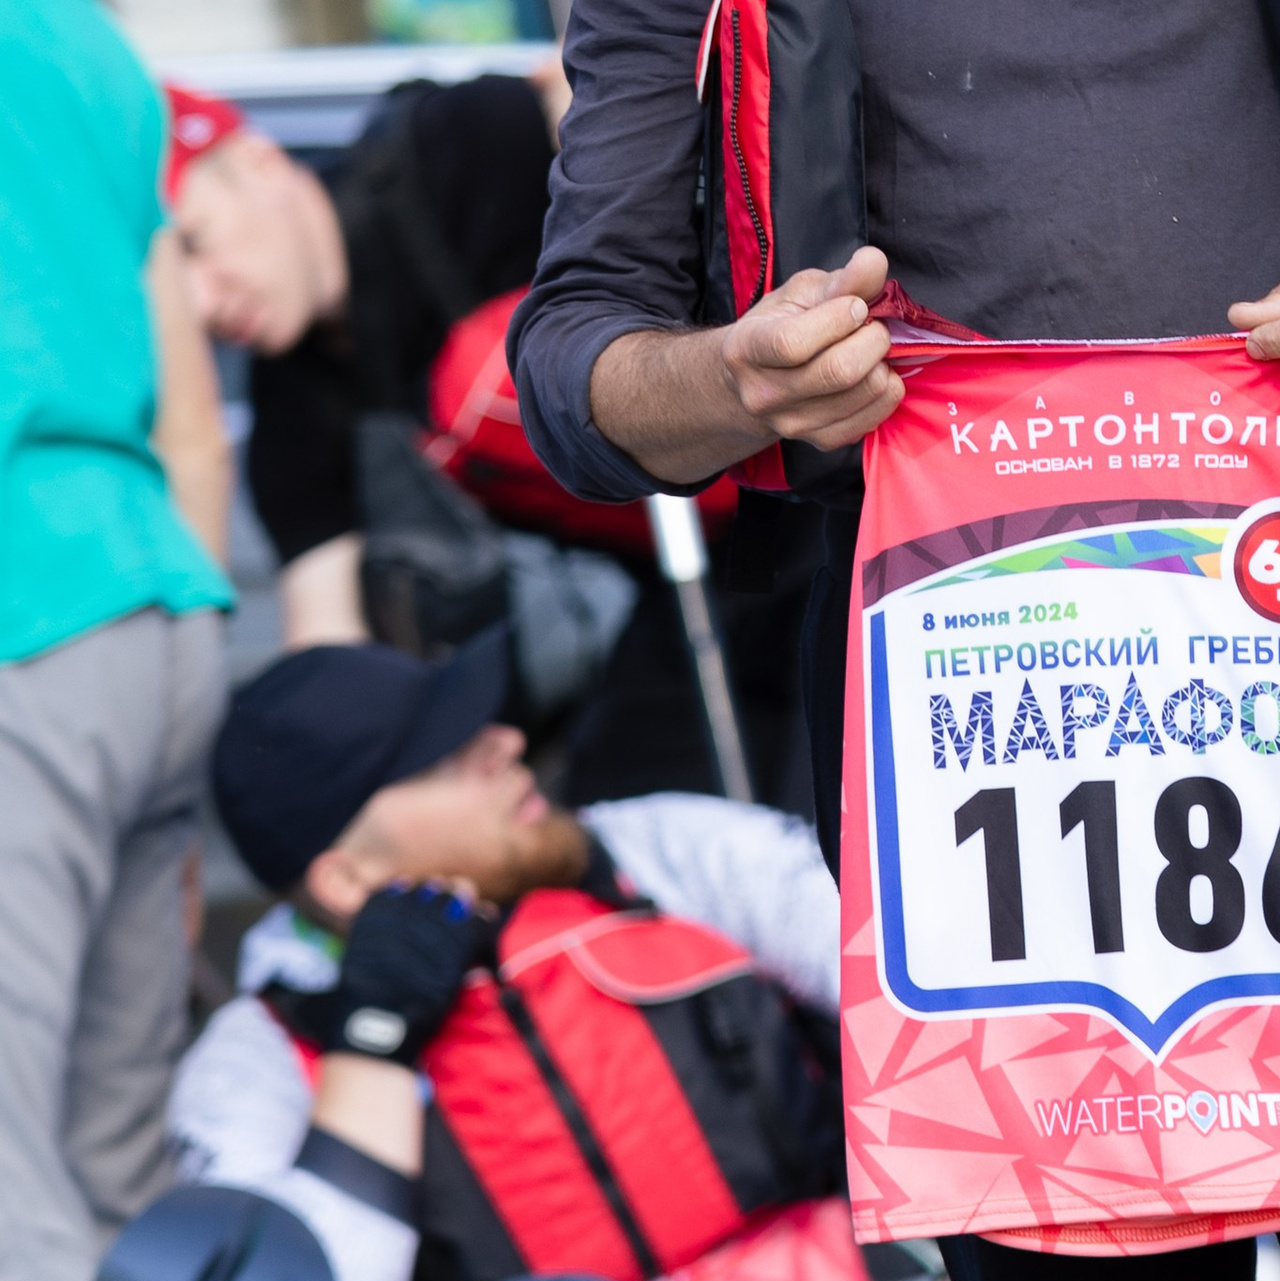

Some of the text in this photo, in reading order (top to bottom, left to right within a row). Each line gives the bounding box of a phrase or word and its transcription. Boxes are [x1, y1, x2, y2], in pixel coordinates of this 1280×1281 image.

[994, 453, 1249, 476] ОСНОВАН В 1872 ГОДУ
[922, 601, 1079, 631] 8 июня 2024
[925, 627, 1159, 679] ПЕТРОВСКИЙ
